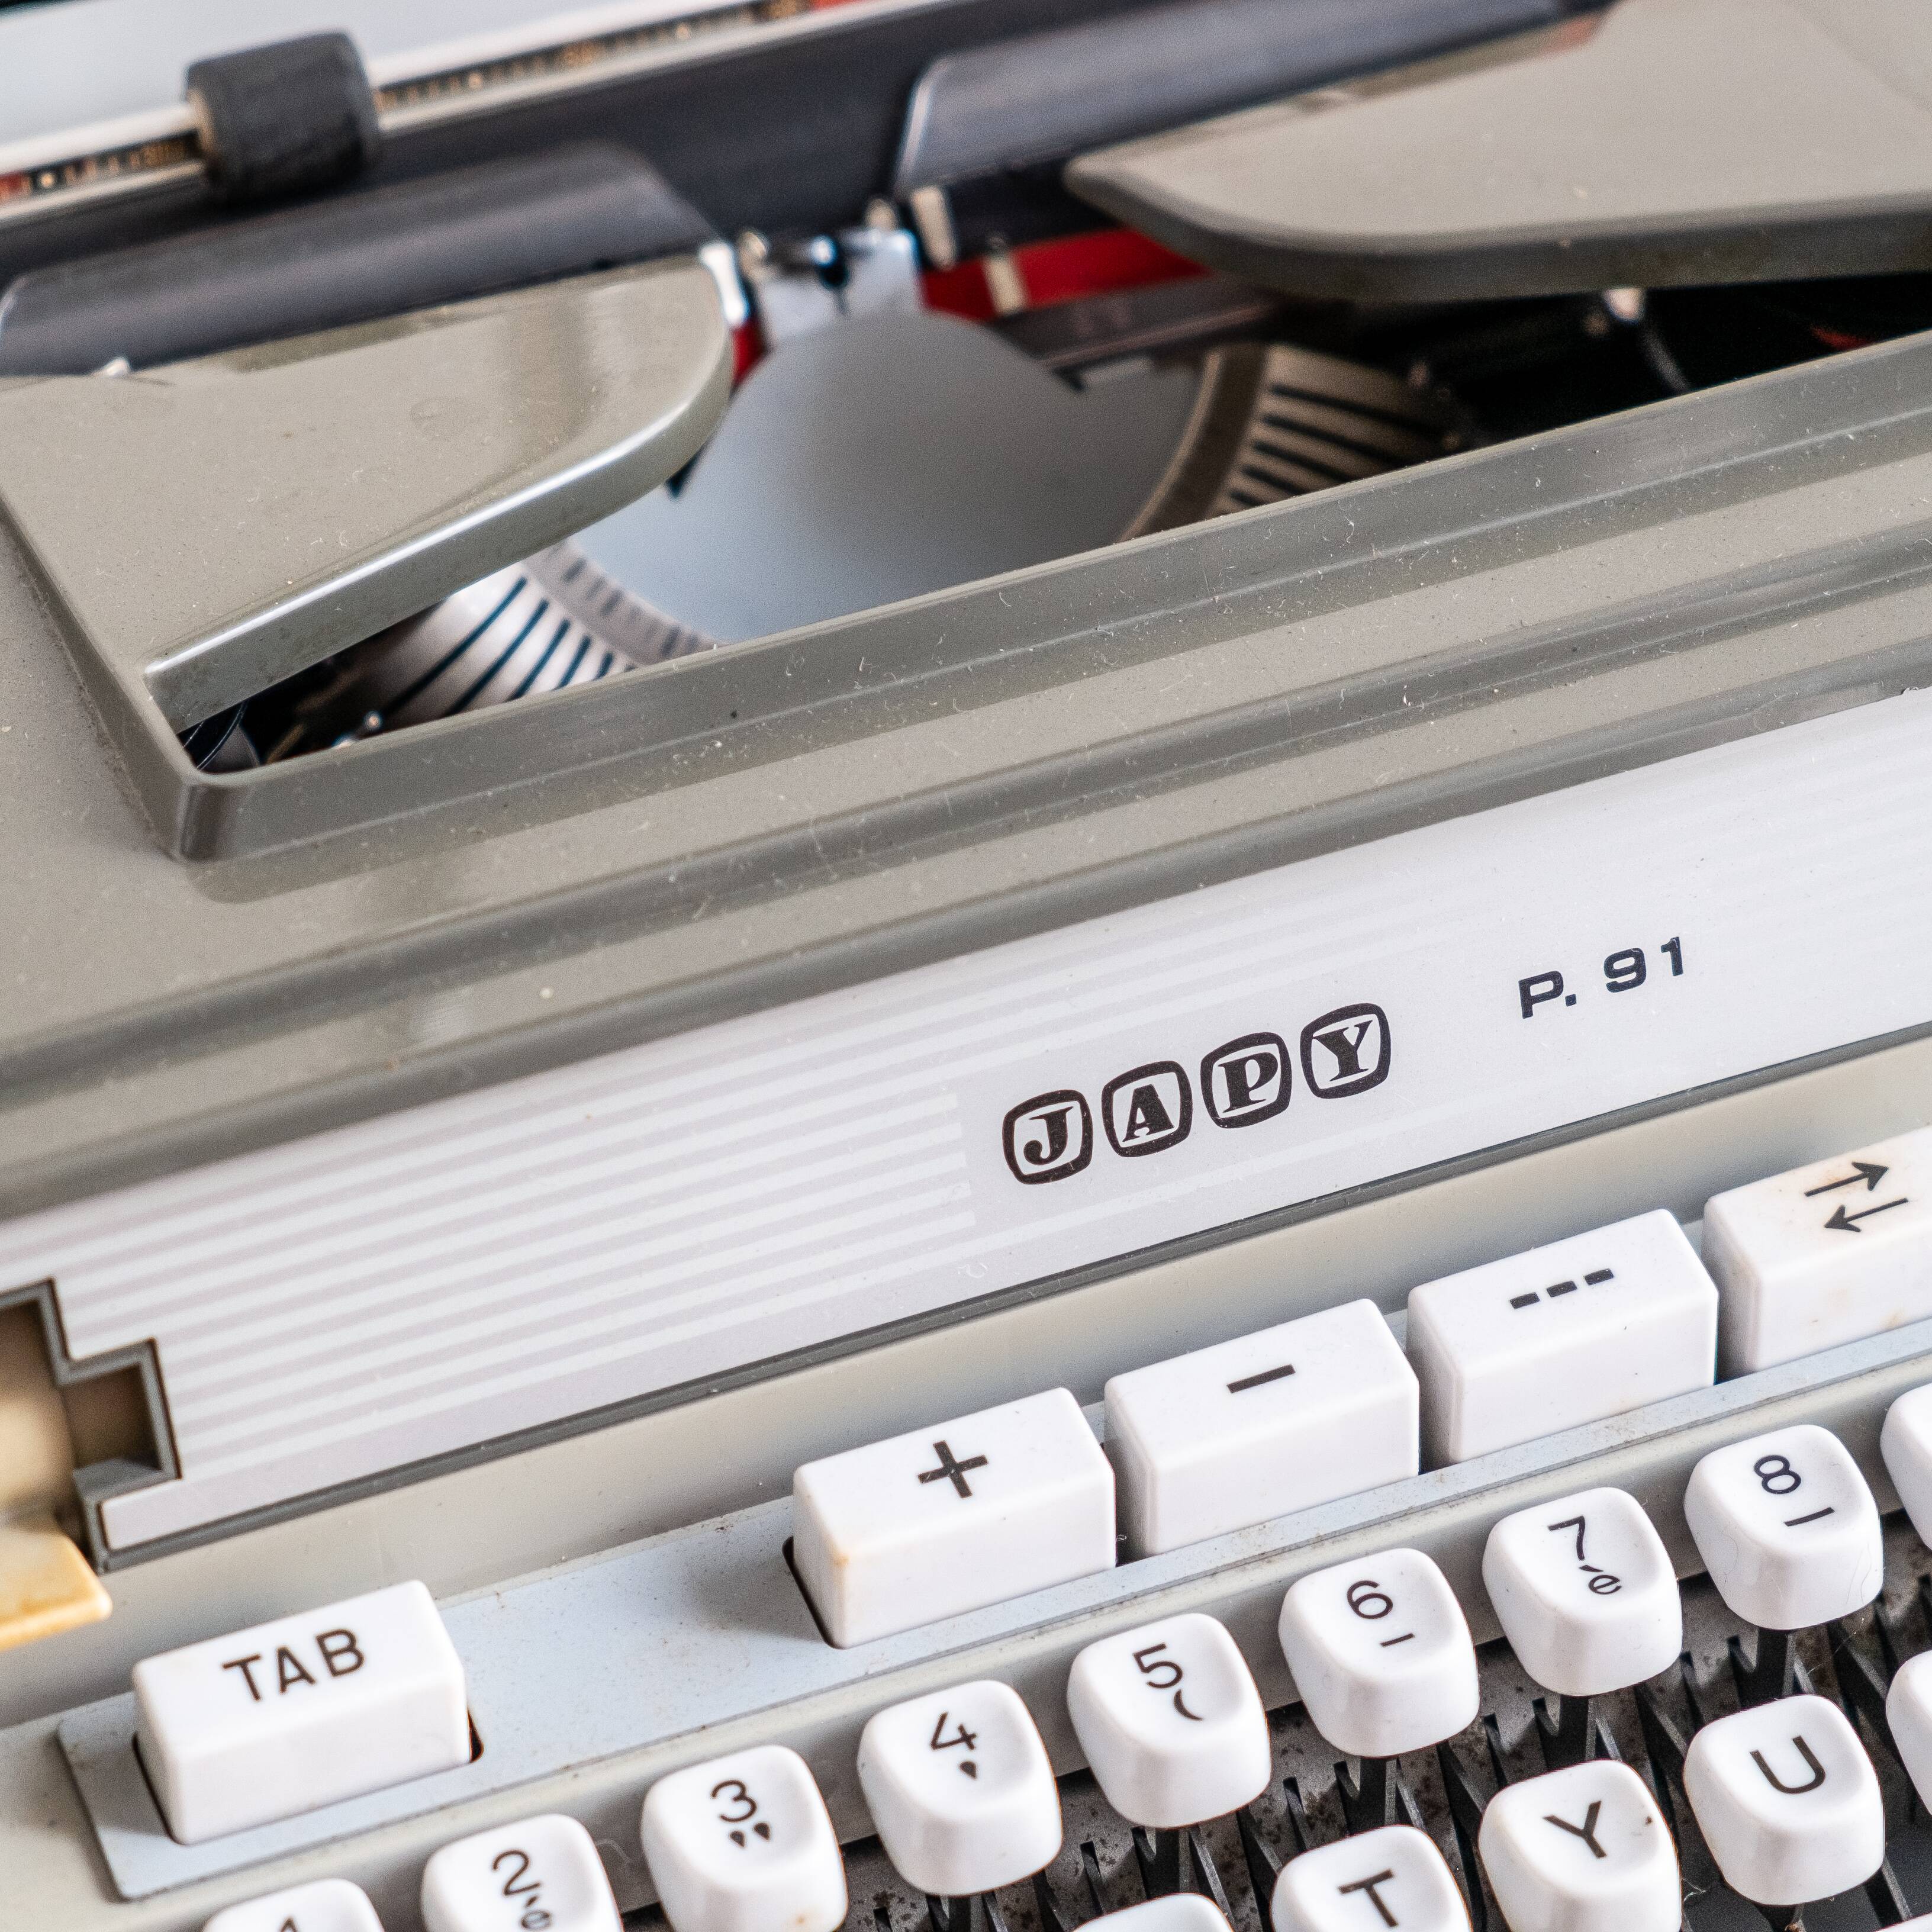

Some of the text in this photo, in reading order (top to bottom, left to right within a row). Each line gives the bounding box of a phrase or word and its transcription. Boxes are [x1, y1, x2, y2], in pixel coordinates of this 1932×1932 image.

[1519, 936, 1683, 1019] P. 91
[1015, 1013, 1383, 1173] JAPY
[1753, 1455, 1801, 1495] 8
[1548, 1515, 1586, 1561] 7
[1347, 1580, 1393, 1619] 6
[223, 1629, 364, 1701] TAB
[1134, 1643, 1183, 1689] 5
[930, 1712, 977, 1750] 4
[1750, 1735, 1826, 1794] U
[711, 1780, 757, 1822] 3
[1544, 1801, 1606, 1858] Y
[492, 1850, 542, 1896] 2
[1338, 1869, 1398, 1928] T
